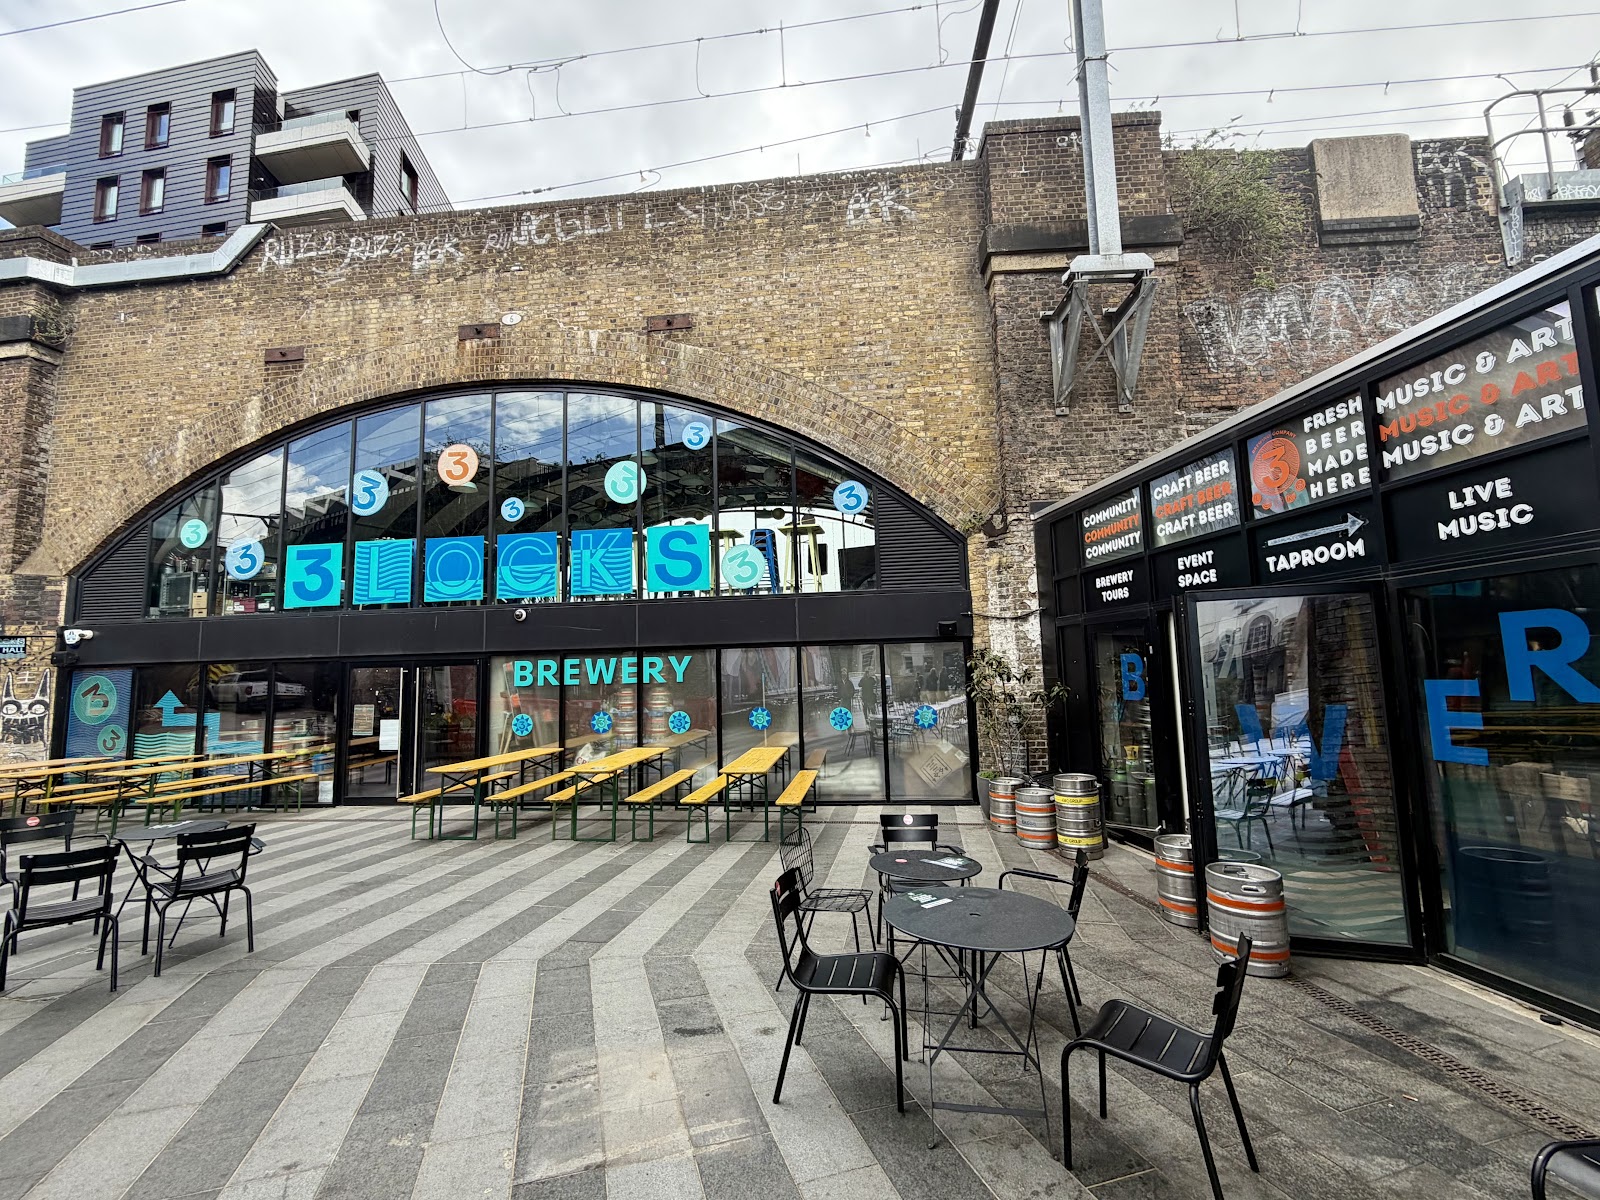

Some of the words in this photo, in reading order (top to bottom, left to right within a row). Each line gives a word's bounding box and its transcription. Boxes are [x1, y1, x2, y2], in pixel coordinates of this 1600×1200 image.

[1376, 363, 1466, 414] MUSIC
[1475, 351, 1496, 374] &
[1506, 317, 1574, 363] ART
[1379, 394, 1470, 441] MUSIC
[1480, 383, 1501, 405] &
[1511, 351, 1580, 396] ART
[1303, 395, 1363, 433] FRESH
[1382, 423, 1474, 468] MUSIC
[1484, 413, 1505, 436] &
[1515, 385, 1585, 429] ART
[688, 426, 706, 446] 3
[1272, 429, 1297, 440] COMPANY
[1306, 420, 1366, 455] BEER
[445, 451, 470, 480] 3
[1262, 445, 1290, 488] 3
[1308, 443, 1369, 477] MADE
[352, 474, 383, 511] 3
[609, 465, 638, 499] 3
[1153, 474, 1192, 500] CRAFT
[1194, 459, 1230, 484] BEER
[1310, 466, 1372, 499] HERE
[1448, 477, 1513, 510] LIVE
[506, 500, 522, 520] 3
[838, 484, 863, 510] 3
[1083, 495, 1138, 528] COMMUNITY
[1155, 494, 1194, 519] CRAFT
[1197, 481, 1232, 504] BEER
[184, 524, 202, 544] 3
[1084, 513, 1139, 543] COMMUNITY
[1156, 514, 1196, 538] CRAFT
[1198, 502, 1234, 525] BEER
[1437, 503, 1534, 540] MUSIC
[231, 541, 257, 575] 3
[1086, 531, 1141, 559] COMMUNITY
[1177, 550, 1214, 570] EVENT
[1266, 538, 1366, 573] TAPROOM
[727, 550, 757, 583] 3
[1095, 570, 1133, 589] BREWERY
[1178, 569, 1217, 588] SPACE
[1101, 587, 1129, 602] TOURS
[514, 655, 692, 687] BREWERY
[102, 729, 122, 752] 3
